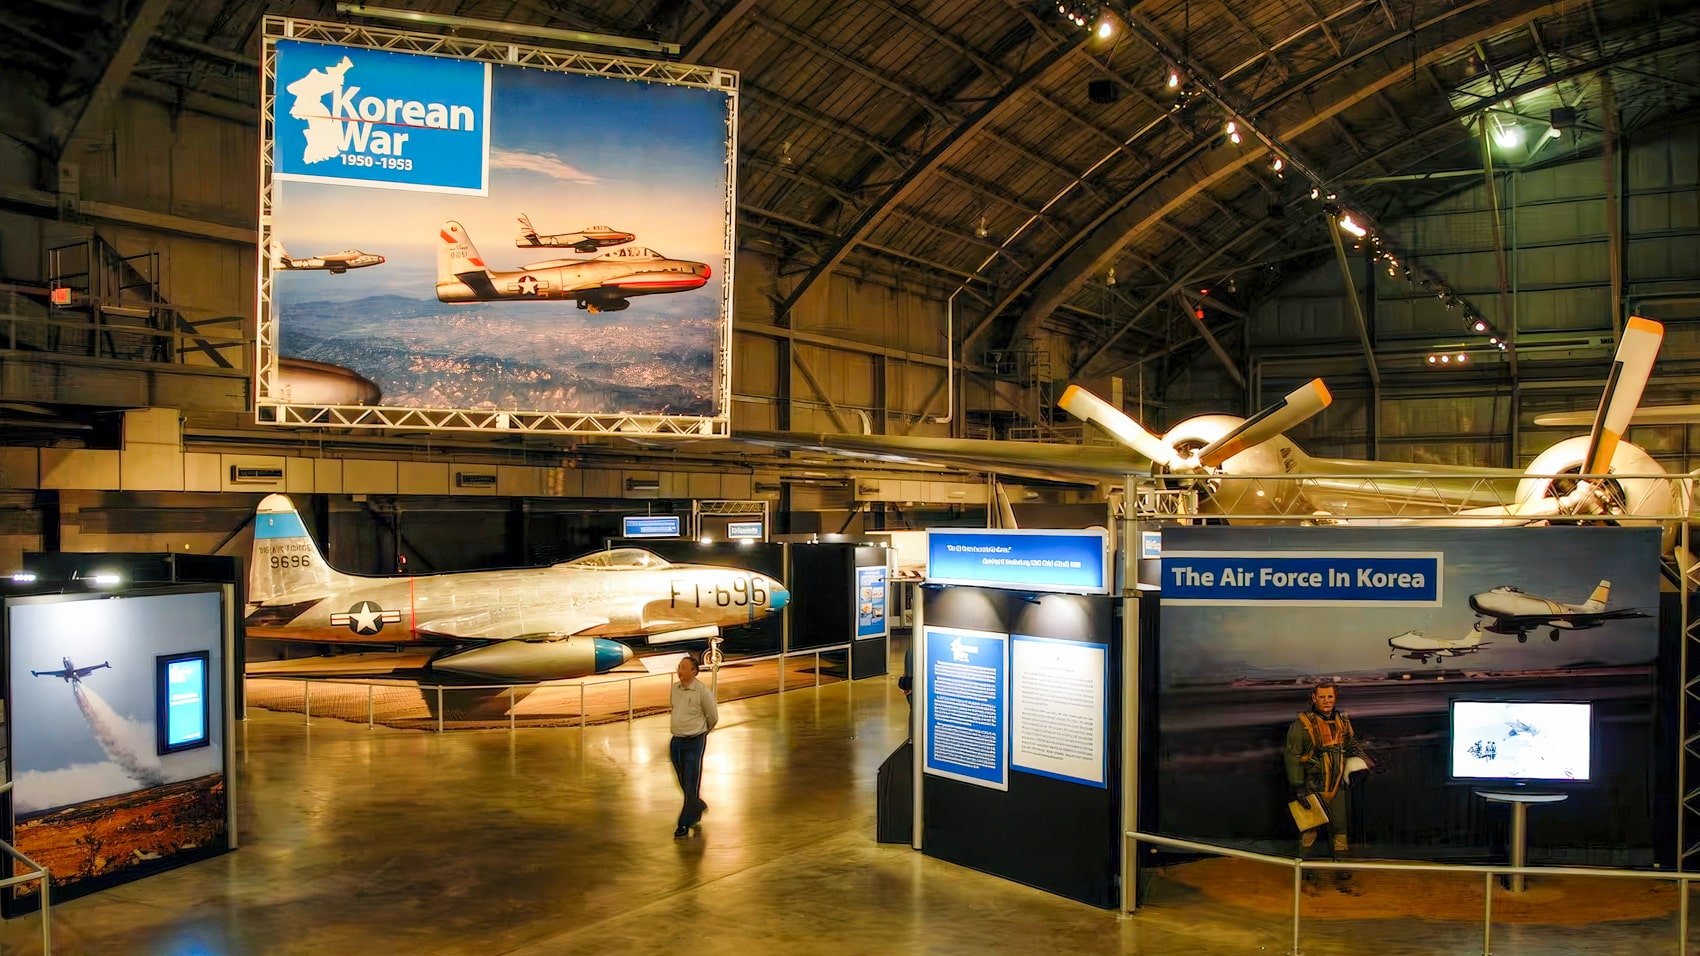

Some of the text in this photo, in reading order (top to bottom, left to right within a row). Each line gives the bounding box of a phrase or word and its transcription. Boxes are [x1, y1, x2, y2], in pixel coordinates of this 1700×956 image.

[331, 86, 475, 131] Korean
[335, 121, 409, 156] War
[271, 554, 310, 569] 9696
[1171, 567, 1425, 588] The Air Force In Korea
